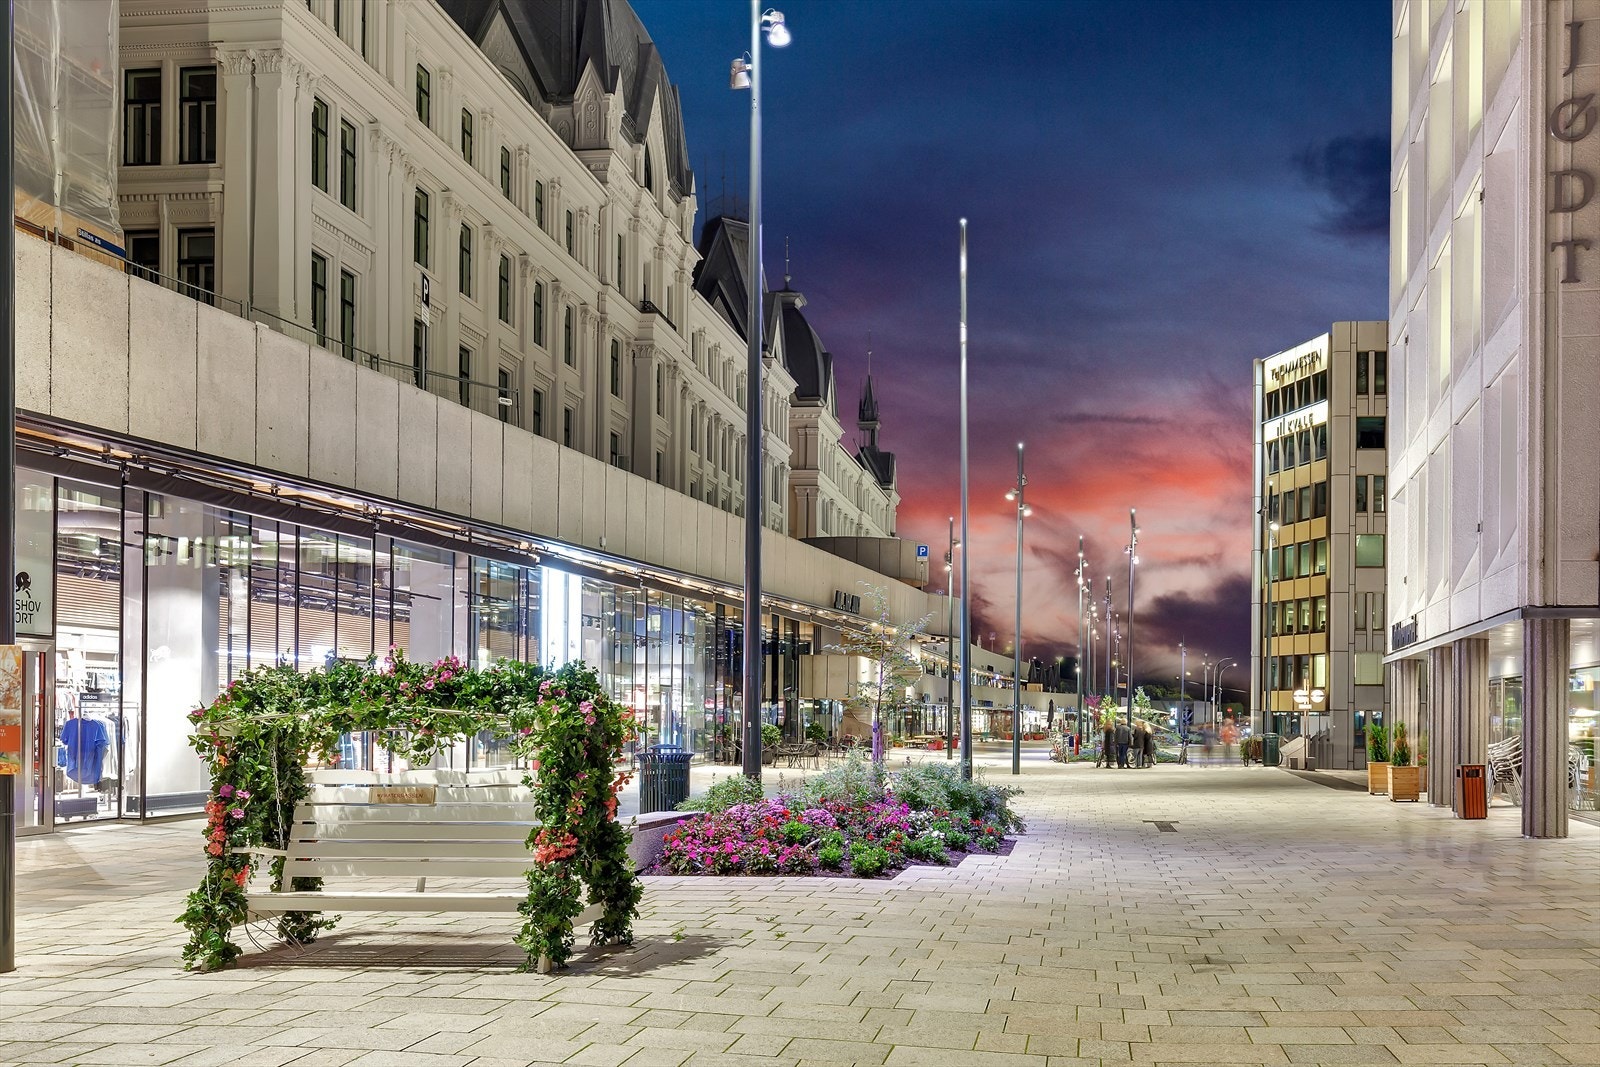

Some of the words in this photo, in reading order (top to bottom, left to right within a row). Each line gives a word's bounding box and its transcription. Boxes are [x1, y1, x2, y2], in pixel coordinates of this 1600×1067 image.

[423, 279, 429, 301] P
[919, 547, 926, 556] P
[16, 599, 41, 612] SHOV
[16, 612, 34, 624] ORT
